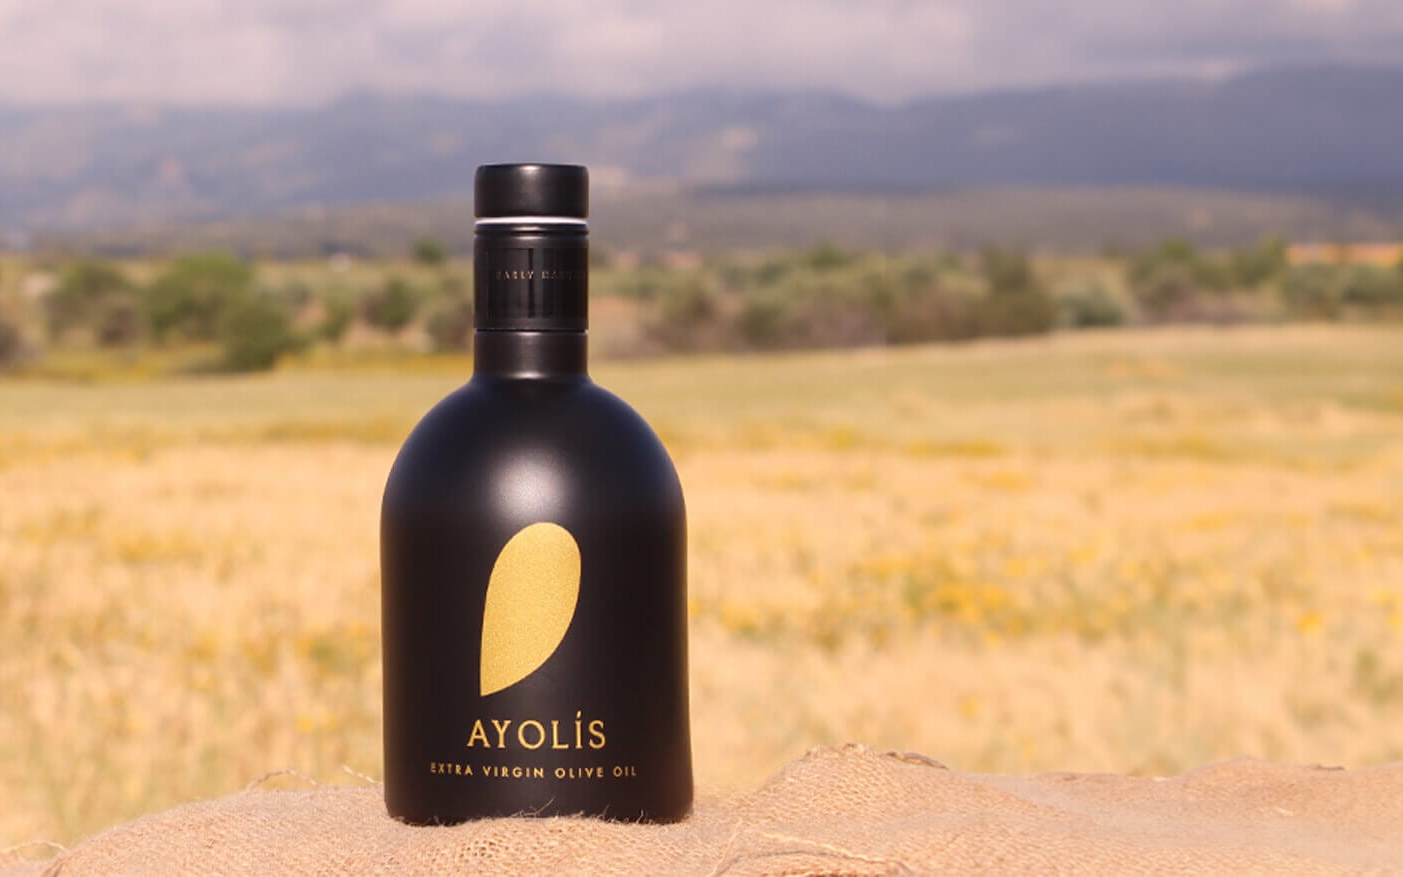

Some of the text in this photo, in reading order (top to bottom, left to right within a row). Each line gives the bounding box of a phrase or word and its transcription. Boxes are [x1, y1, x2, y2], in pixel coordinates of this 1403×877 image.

[430, 761, 637, 779] EXTRA VIRGIN OLIVE OIL
